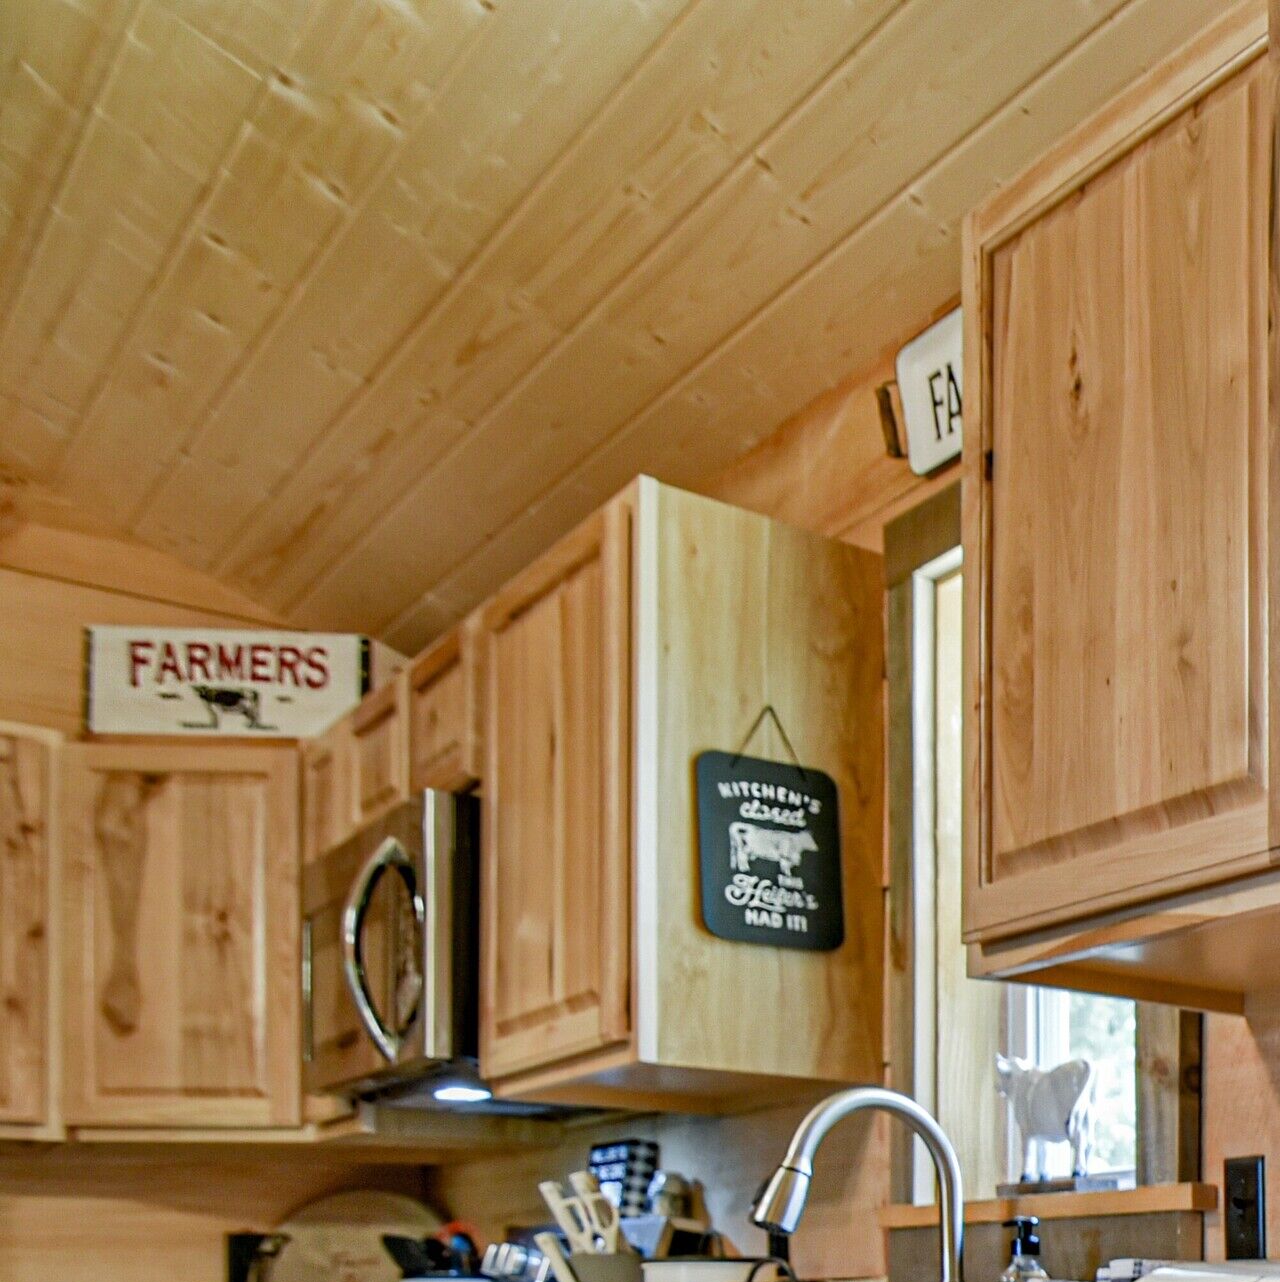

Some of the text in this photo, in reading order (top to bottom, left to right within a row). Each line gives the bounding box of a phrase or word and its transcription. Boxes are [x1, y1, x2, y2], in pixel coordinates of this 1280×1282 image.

[127, 640, 331, 690] FARMERS
[717, 780, 823, 815] KITCHEN'S
[744, 908, 784, 928] HAD
